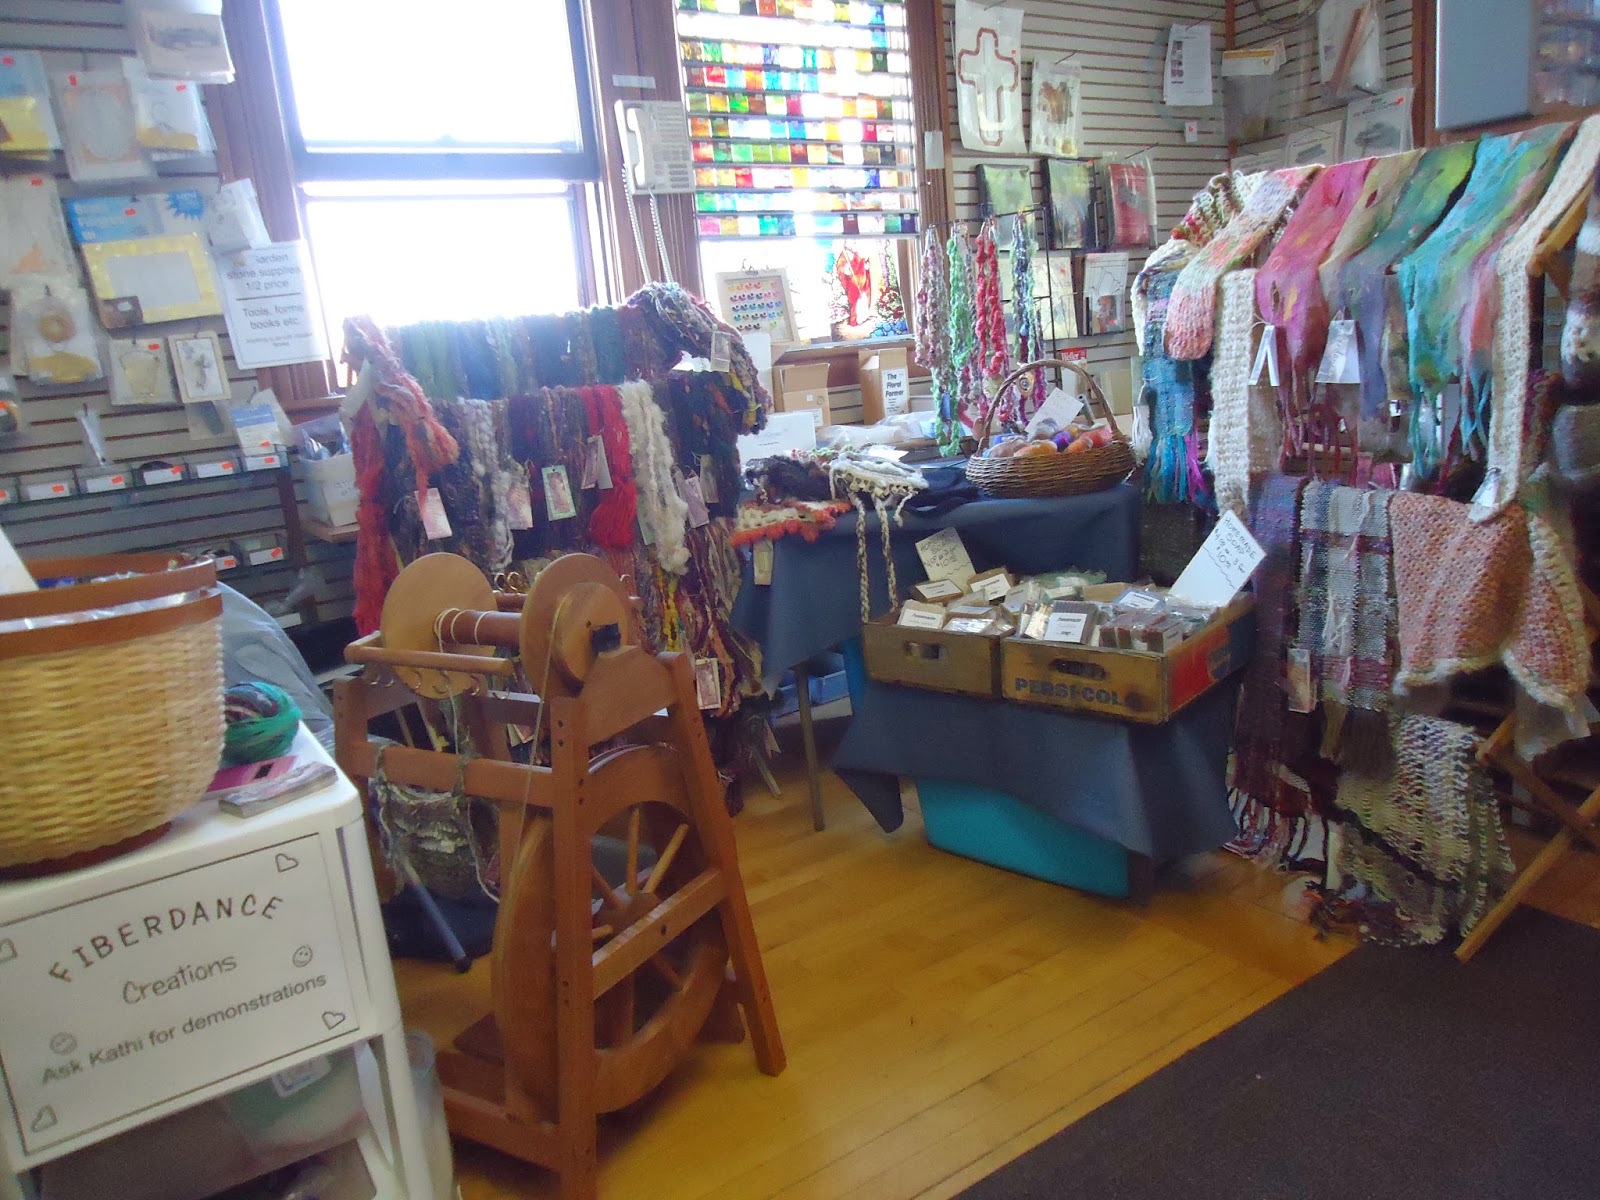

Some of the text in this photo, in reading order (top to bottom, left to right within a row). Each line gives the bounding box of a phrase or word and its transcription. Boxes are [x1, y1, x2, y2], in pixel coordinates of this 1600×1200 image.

[226, 266, 302, 280] stone supplies
[264, 280, 289, 291] price
[250, 319, 281, 330] books
[886, 381, 902, 389] Floral
[1223, 516, 1258, 560] HOMEMADE
[1226, 532, 1245, 555] SOAP
[49, 893, 284, 983] FIBERDANCE
[122, 955, 238, 1005] Creations
[43, 973, 328, 1084] Ask Kathi for demonstrations
